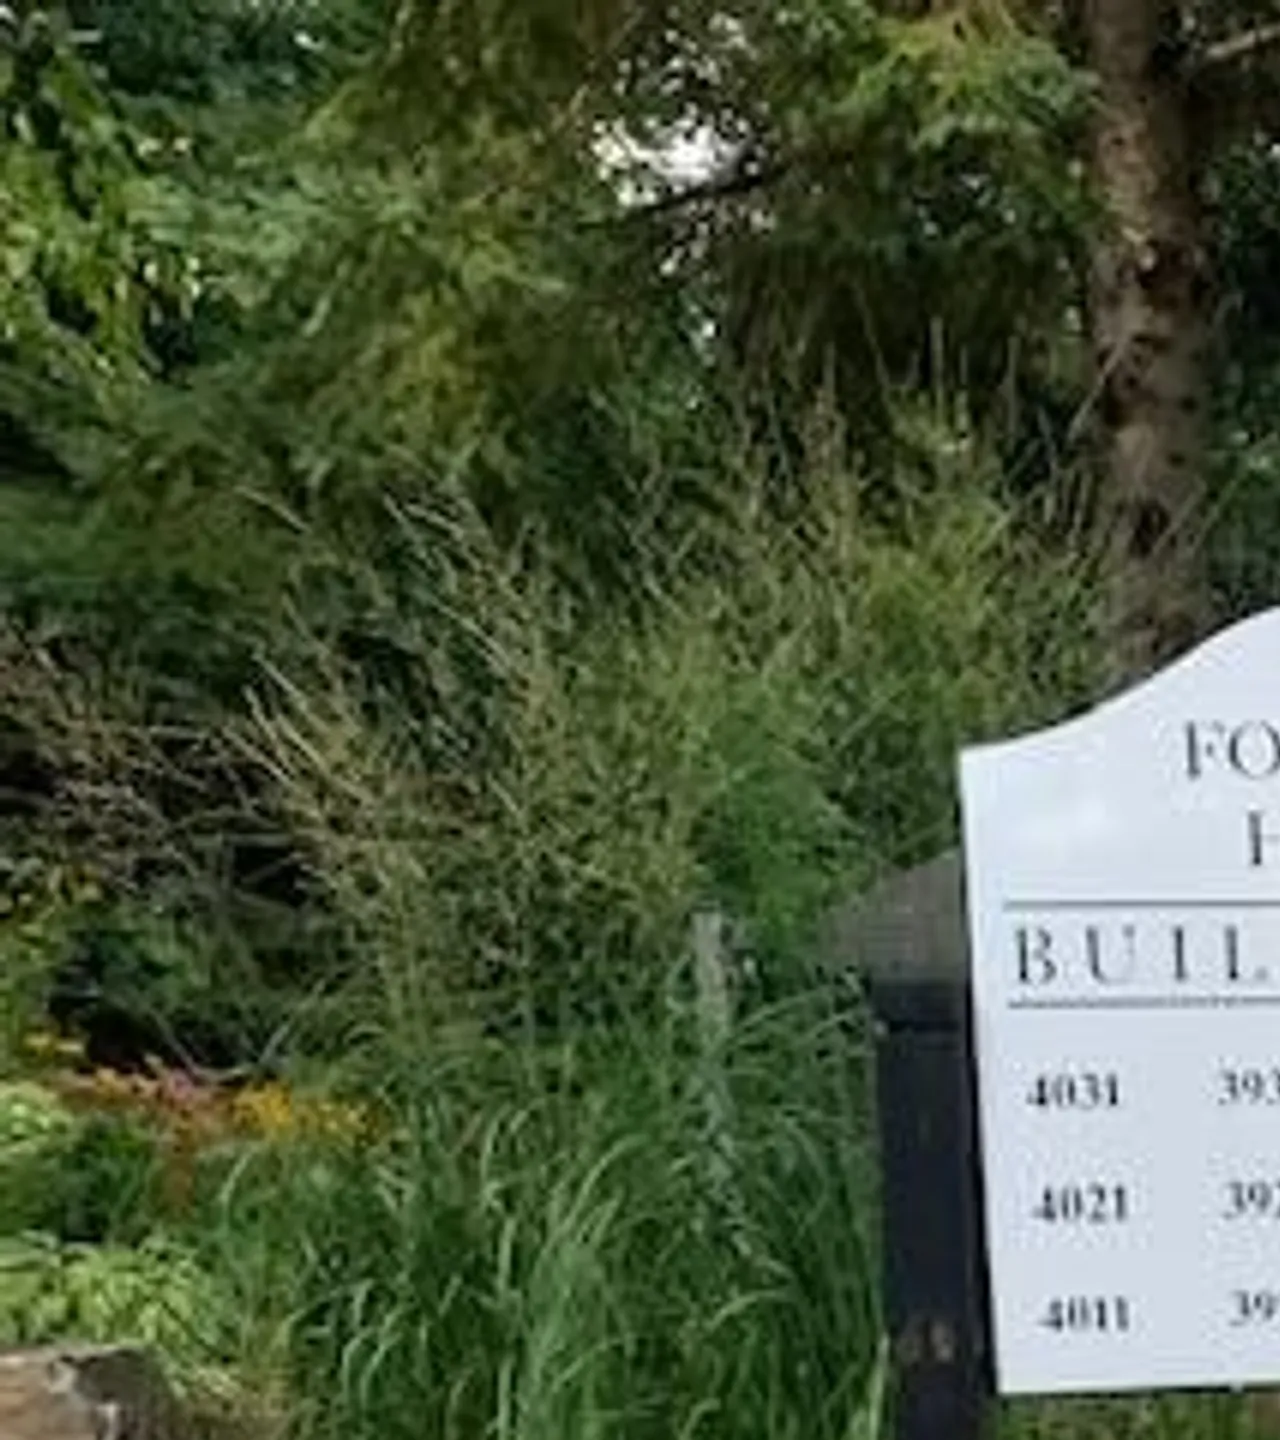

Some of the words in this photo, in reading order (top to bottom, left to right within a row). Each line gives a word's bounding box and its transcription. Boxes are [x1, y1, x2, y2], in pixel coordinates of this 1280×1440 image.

[1024, 1071, 1120, 1111] 4031
[1031, 1181, 1128, 1225] 4021
[1037, 1294, 1130, 1333] 4011
